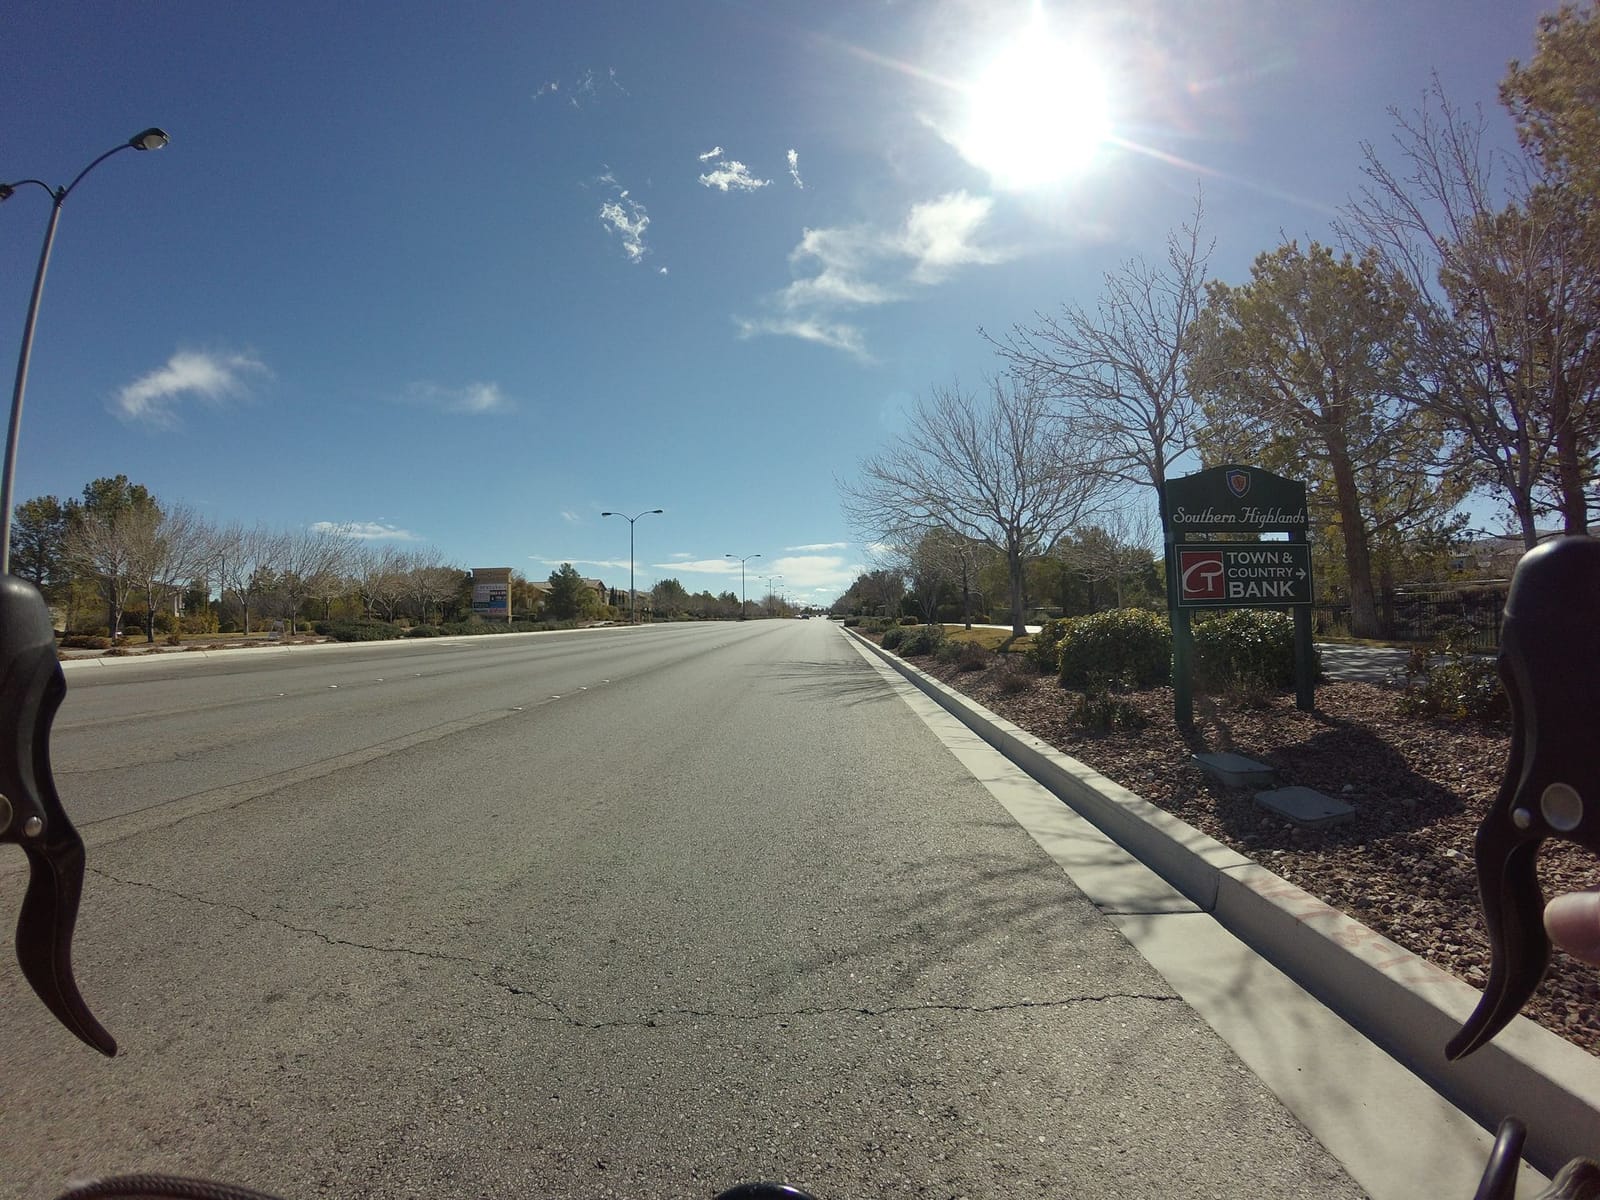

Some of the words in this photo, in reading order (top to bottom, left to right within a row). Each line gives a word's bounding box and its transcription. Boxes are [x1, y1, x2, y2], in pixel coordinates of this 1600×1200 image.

[1173, 506, 1236, 524] Southern
[1238, 506, 1305, 529] Highlands
[1226, 552, 1279, 565] TOWN
[1282, 552, 1293, 564] &
[1227, 567, 1294, 579] COUNTRY
[1229, 580, 1296, 599] BANK
